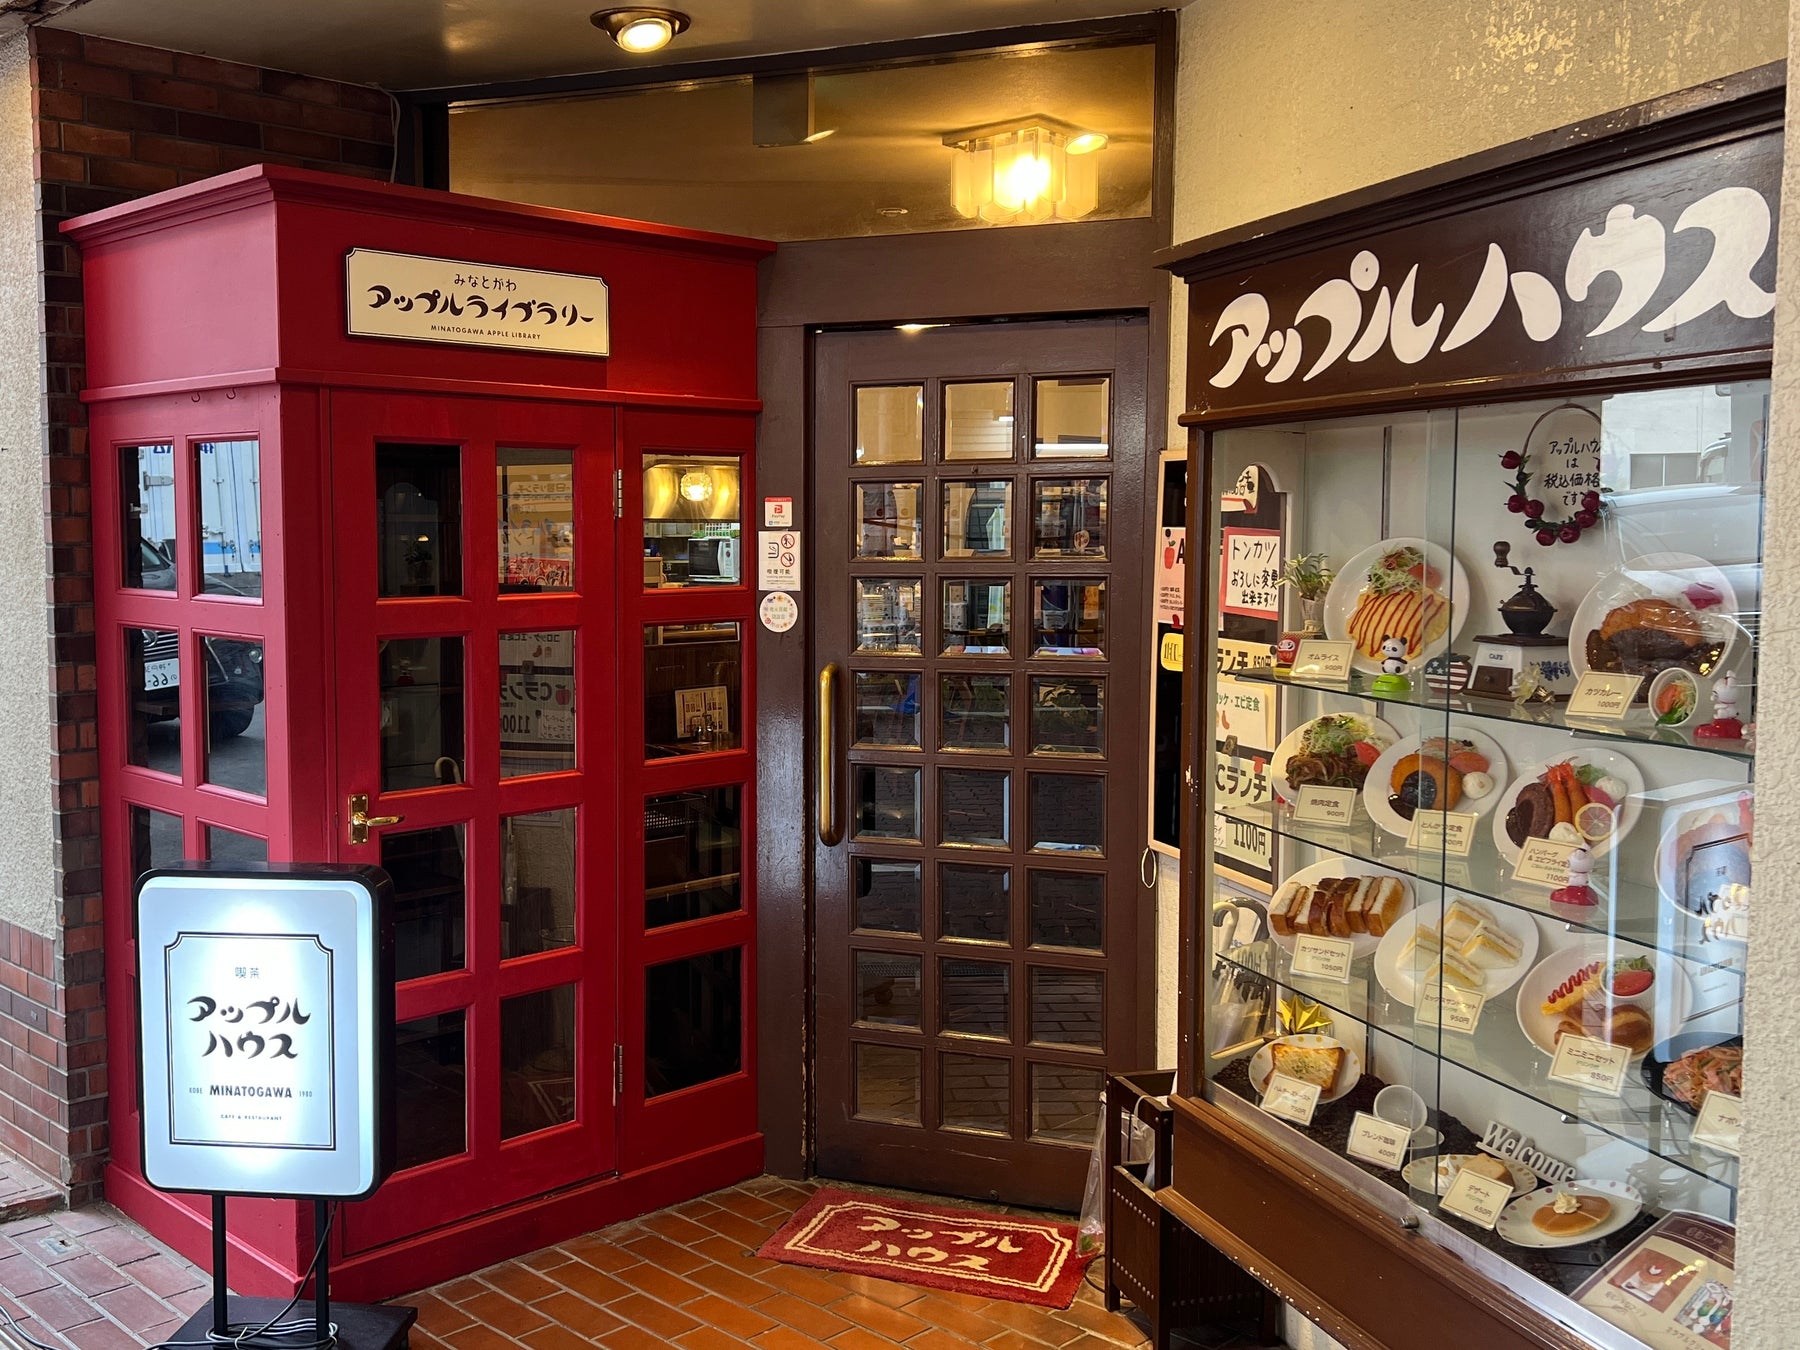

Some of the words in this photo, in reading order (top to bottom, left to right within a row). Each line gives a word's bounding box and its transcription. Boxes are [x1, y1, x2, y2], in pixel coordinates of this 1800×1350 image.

[454, 273, 517, 292] みなとがわ
[1208, 186, 1776, 388] アップルハウス
[367, 284, 595, 327] アップルライブラリー
[430, 324, 484, 336] MINATOGAWA
[487, 329, 509, 338] APPLE
[511, 331, 541, 340] LIBRARY
[1566, 458, 1580, 469] は
[1544, 473, 1600, 489] 税込価格
[1562, 490, 1580, 506] です
[1232, 538, 1277, 564] トンカツ
[1231, 568, 1279, 590] おろしに変更
[1307, 652, 1340, 662] オムライス
[1584, 686, 1622, 697] カツカレー
[1217, 692, 1260, 712] ッケ・エビ定食
[1216, 763, 1267, 803] Cランチ
[1529, 848, 1559, 858] ハンバーグ
[235, 966, 260, 979] 喫茶
[186, 995, 312, 1025] アップル
[201, 1030, 298, 1060] ハウス
[1566, 1047, 1616, 1065] ミニミニセット
[189, 1087, 203, 1095] KOBE
[209, 1084, 293, 1099] MINATOGAWA
[1483, 1119, 1577, 1183] Welcome
[856, 1215, 1023, 1254] アップル
[855, 1239, 993, 1272] ハウス
